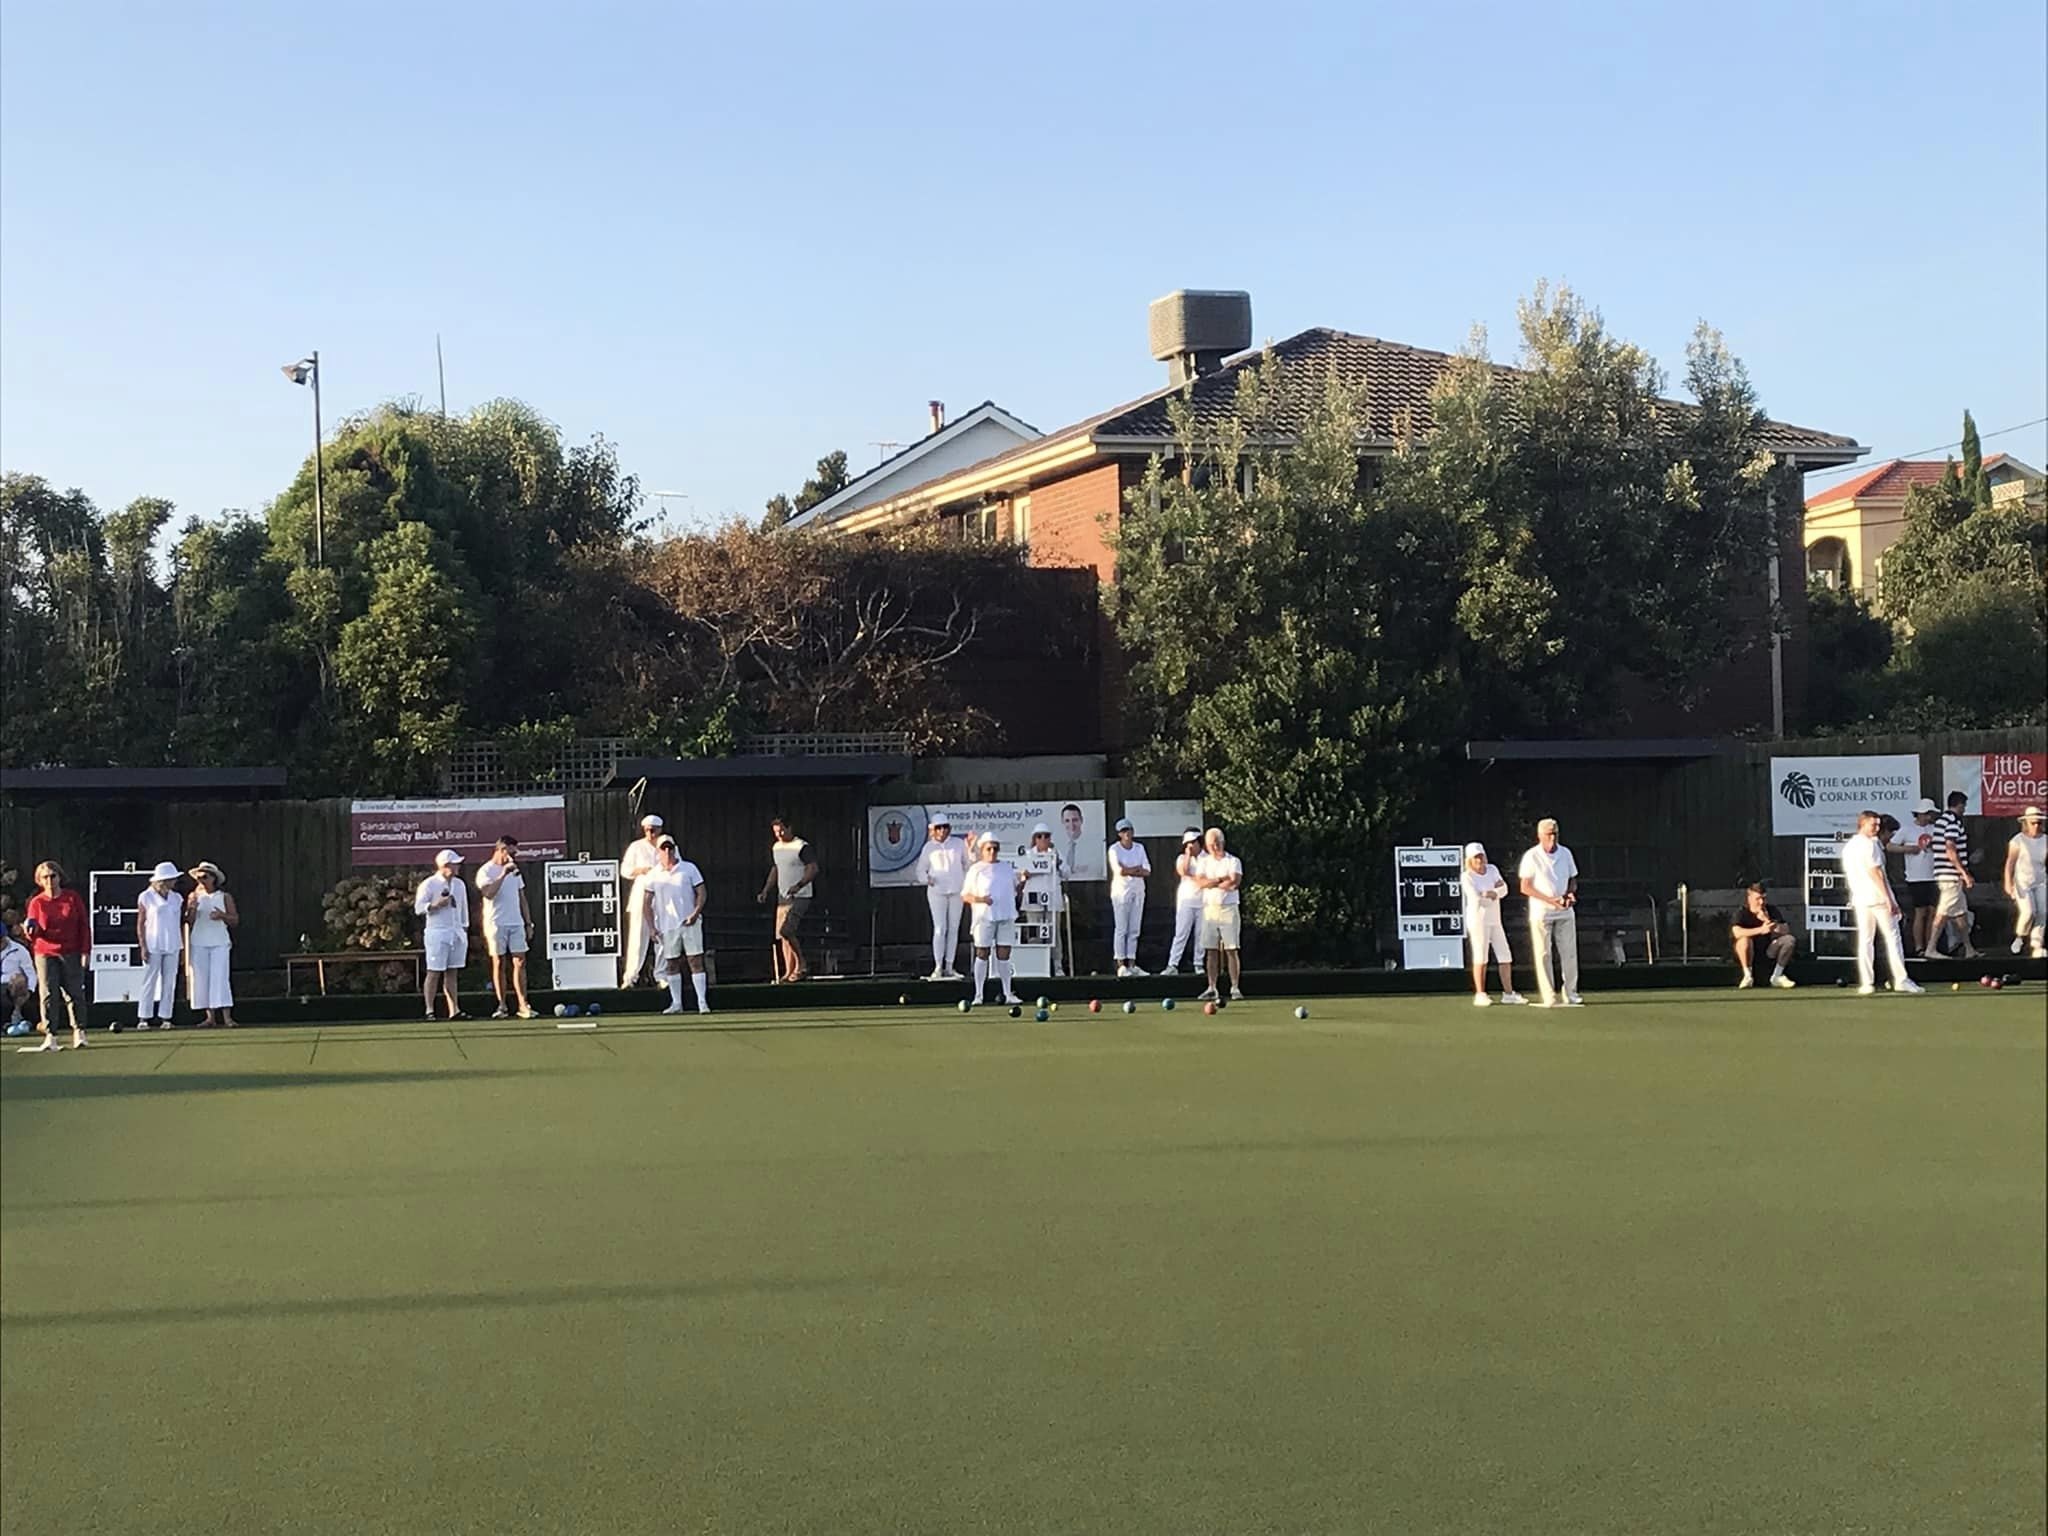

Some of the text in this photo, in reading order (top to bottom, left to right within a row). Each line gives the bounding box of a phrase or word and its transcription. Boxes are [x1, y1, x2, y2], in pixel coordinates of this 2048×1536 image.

[1982, 754, 2033, 776] Little
[1815, 775, 1912, 788] THE GARDENERS
[1819, 790, 1908, 802] CORNER STORE
[973, 809, 1023, 820] Newbury
[1025, 808, 1043, 818] MP
[360, 832, 412, 842] Community
[445, 830, 477, 840] Branch
[1017, 845, 1026, 856] 6
[1033, 861, 1049, 869] VIS
[594, 869, 610, 878] VIS
[1416, 884, 1458, 896] 6 2
[604, 901, 612, 912] 3
[111, 913, 120, 924] 5
[1810, 914, 1838, 923] ENDS
[1403, 918, 1460, 932] ENDS 3
[1041, 926, 1049, 937] 2
[552, 935, 613, 952] ENDS 3
[95, 953, 128, 963] ENDS
